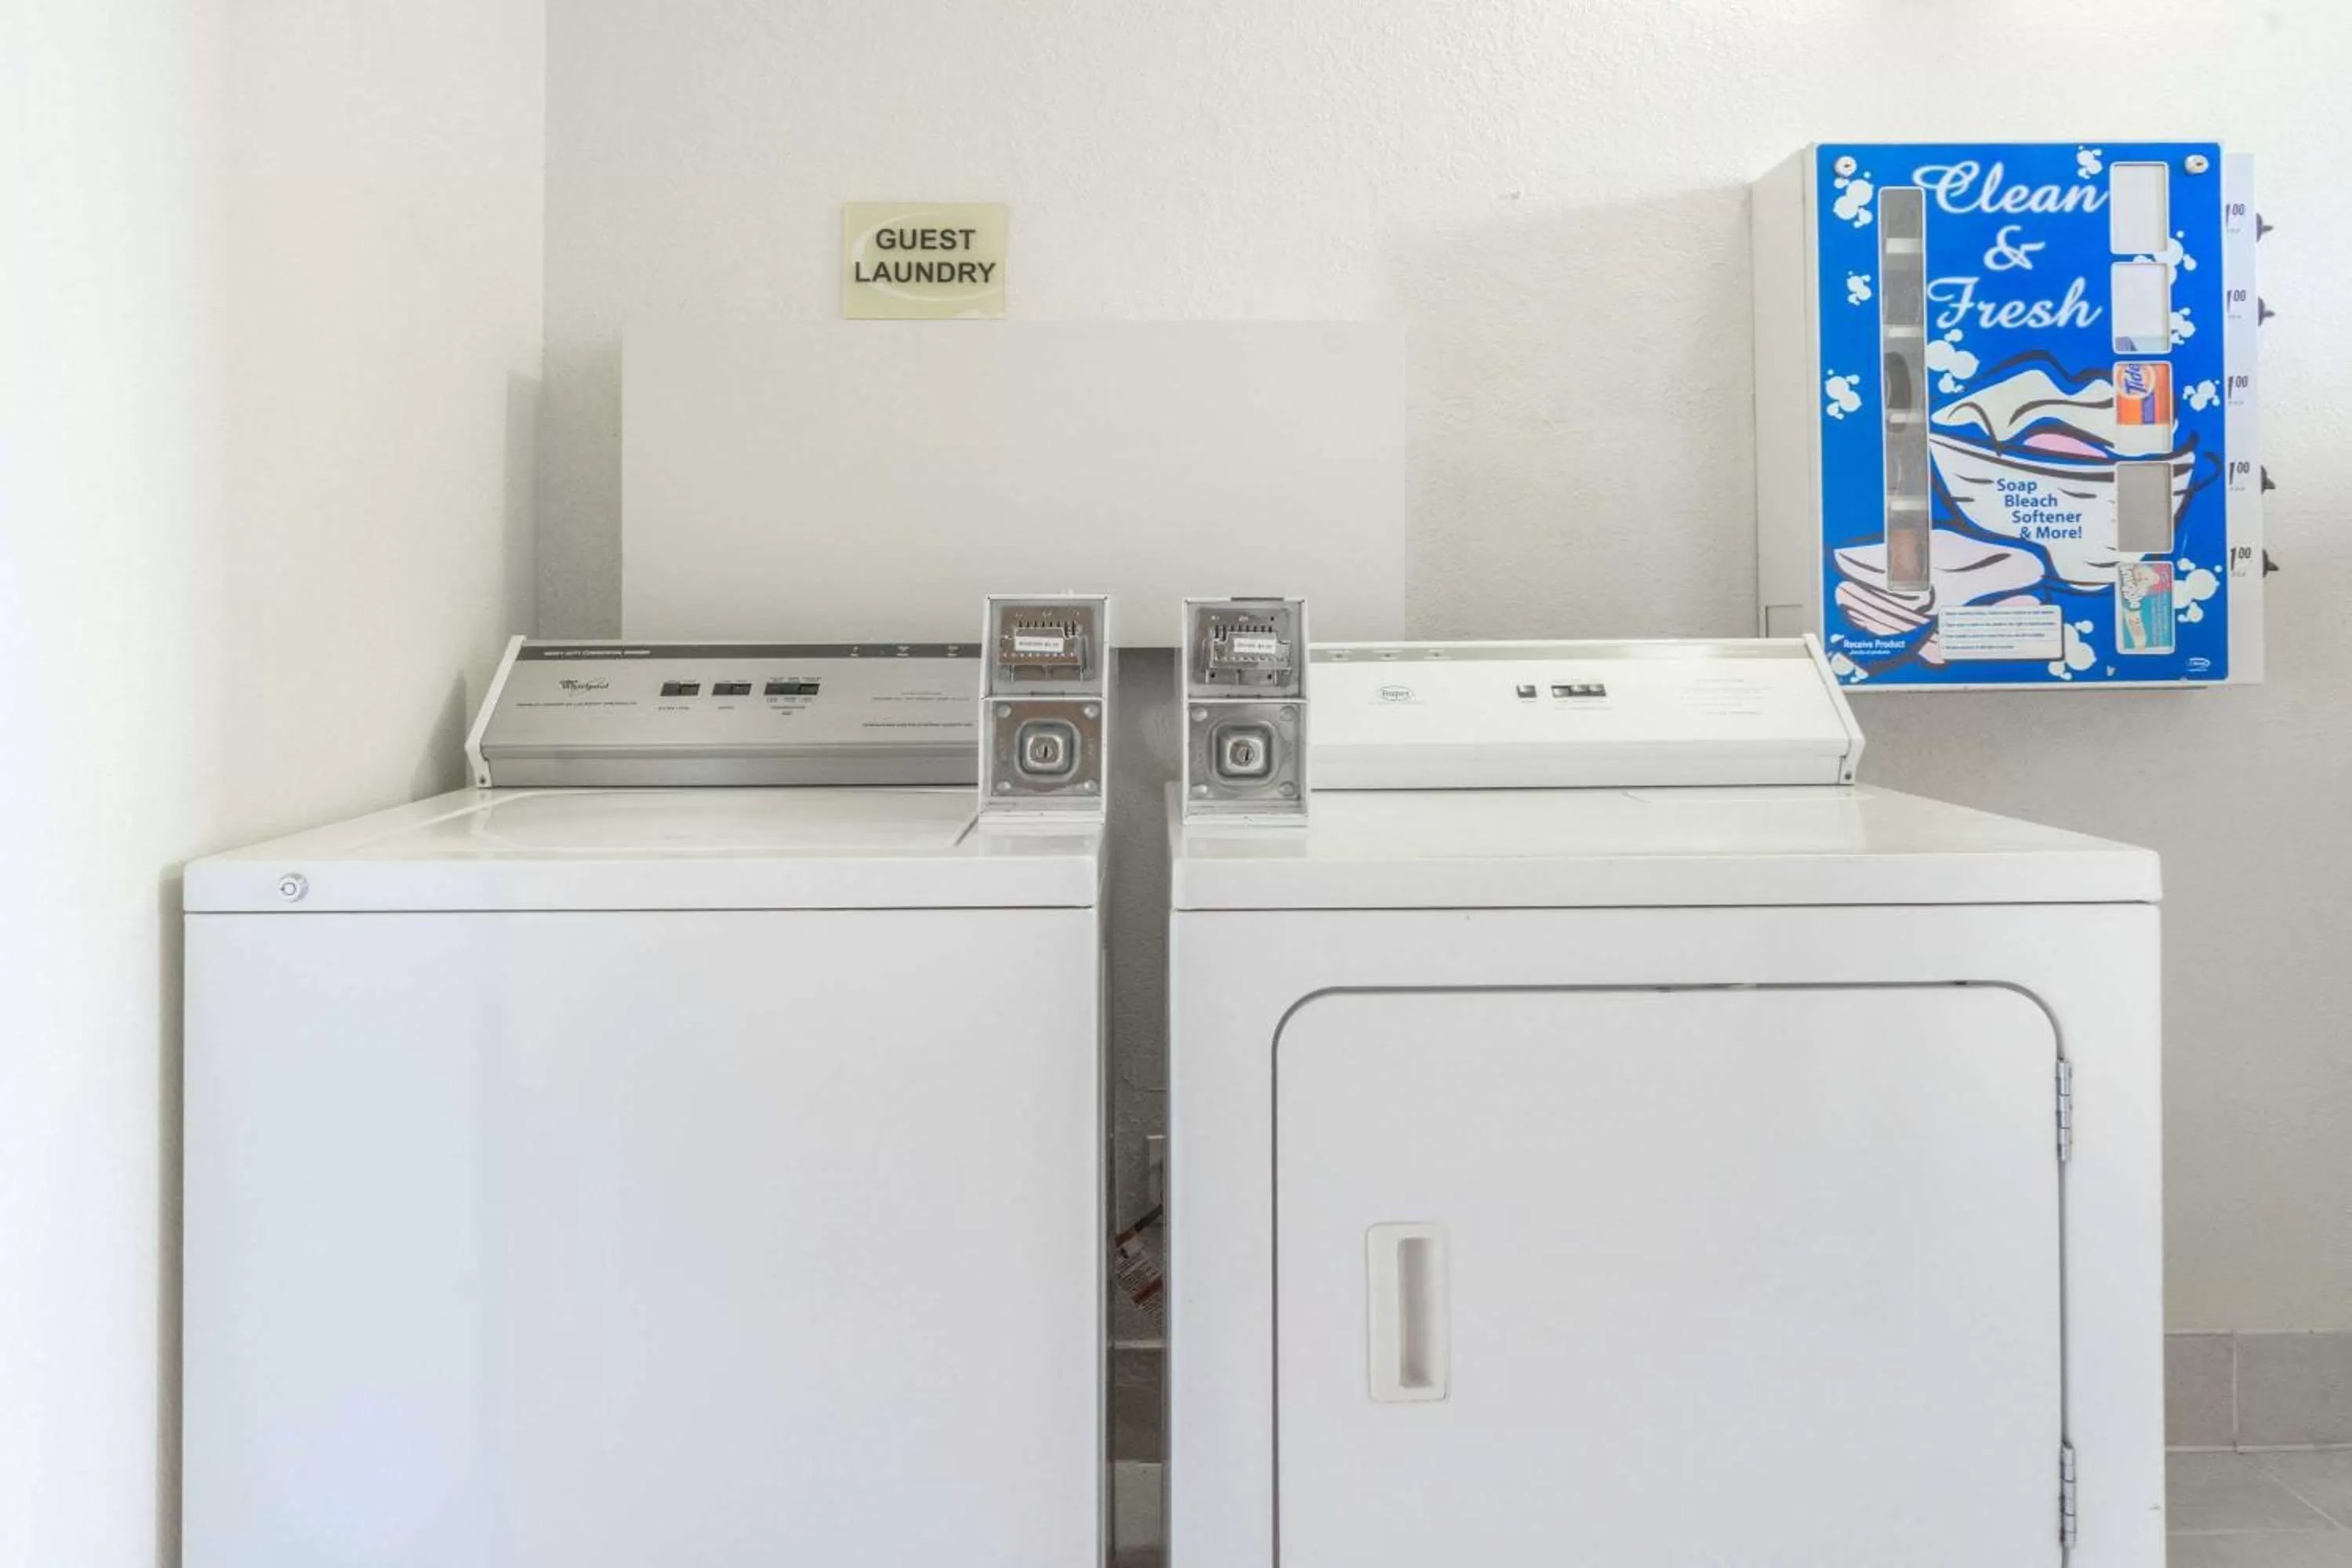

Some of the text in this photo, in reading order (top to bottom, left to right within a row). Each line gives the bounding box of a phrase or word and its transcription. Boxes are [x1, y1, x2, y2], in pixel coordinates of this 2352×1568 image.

[1912, 161, 2109, 213] Clean
[875, 228, 976, 250] GUEST
[1984, 224, 2045, 270] &
[855, 262, 996, 283] LAUNDRY
[1927, 276, 2103, 328] Fresh
[2124, 363, 2147, 394] Tide
[1996, 477, 2038, 494] Soap
[2004, 493, 2058, 508] Bleach
[2012, 510, 2083, 524] Softener
[2020, 524, 2082, 539] & More!
[1843, 639, 1906, 648] Receive Product
[559, 679, 609, 691] Whirlpool
